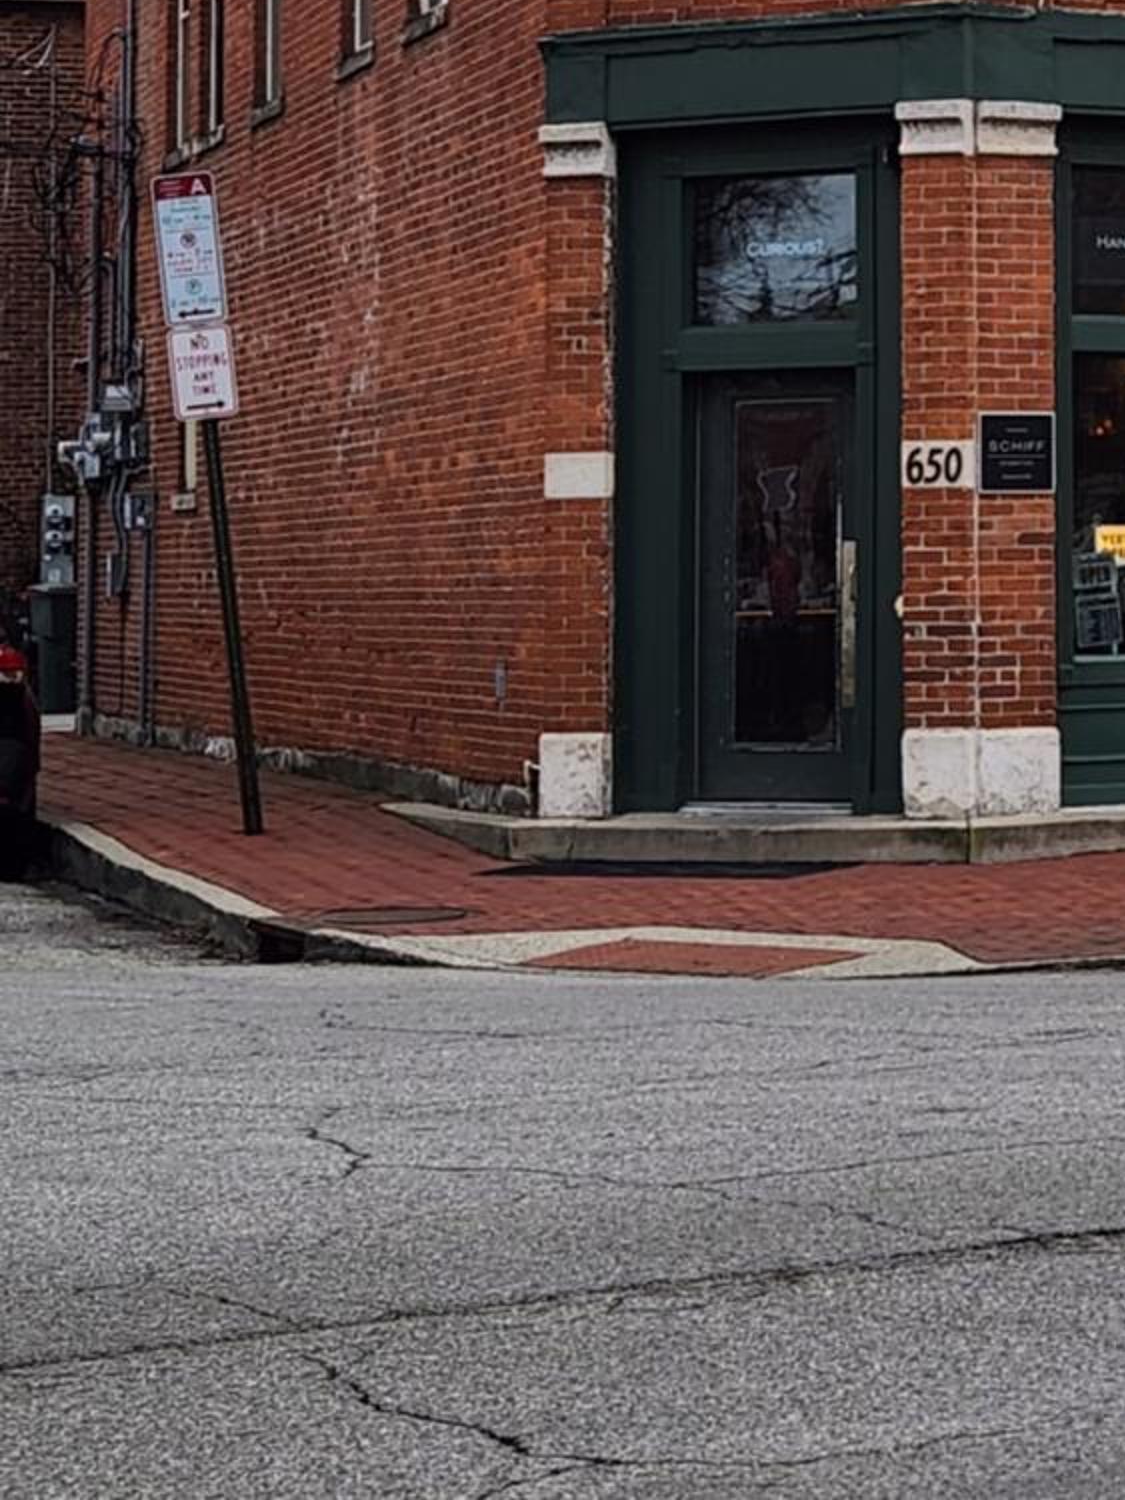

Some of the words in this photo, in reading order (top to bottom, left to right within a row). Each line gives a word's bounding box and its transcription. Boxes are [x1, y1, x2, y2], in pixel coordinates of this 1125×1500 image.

[190, 337, 209, 351] NO
[176, 352, 227, 373] STOPPING
[194, 371, 214, 383] ANY
[191, 383, 216, 397] TIME
[988, 439, 1046, 453] SCHIFF
[906, 446, 963, 485] 650
